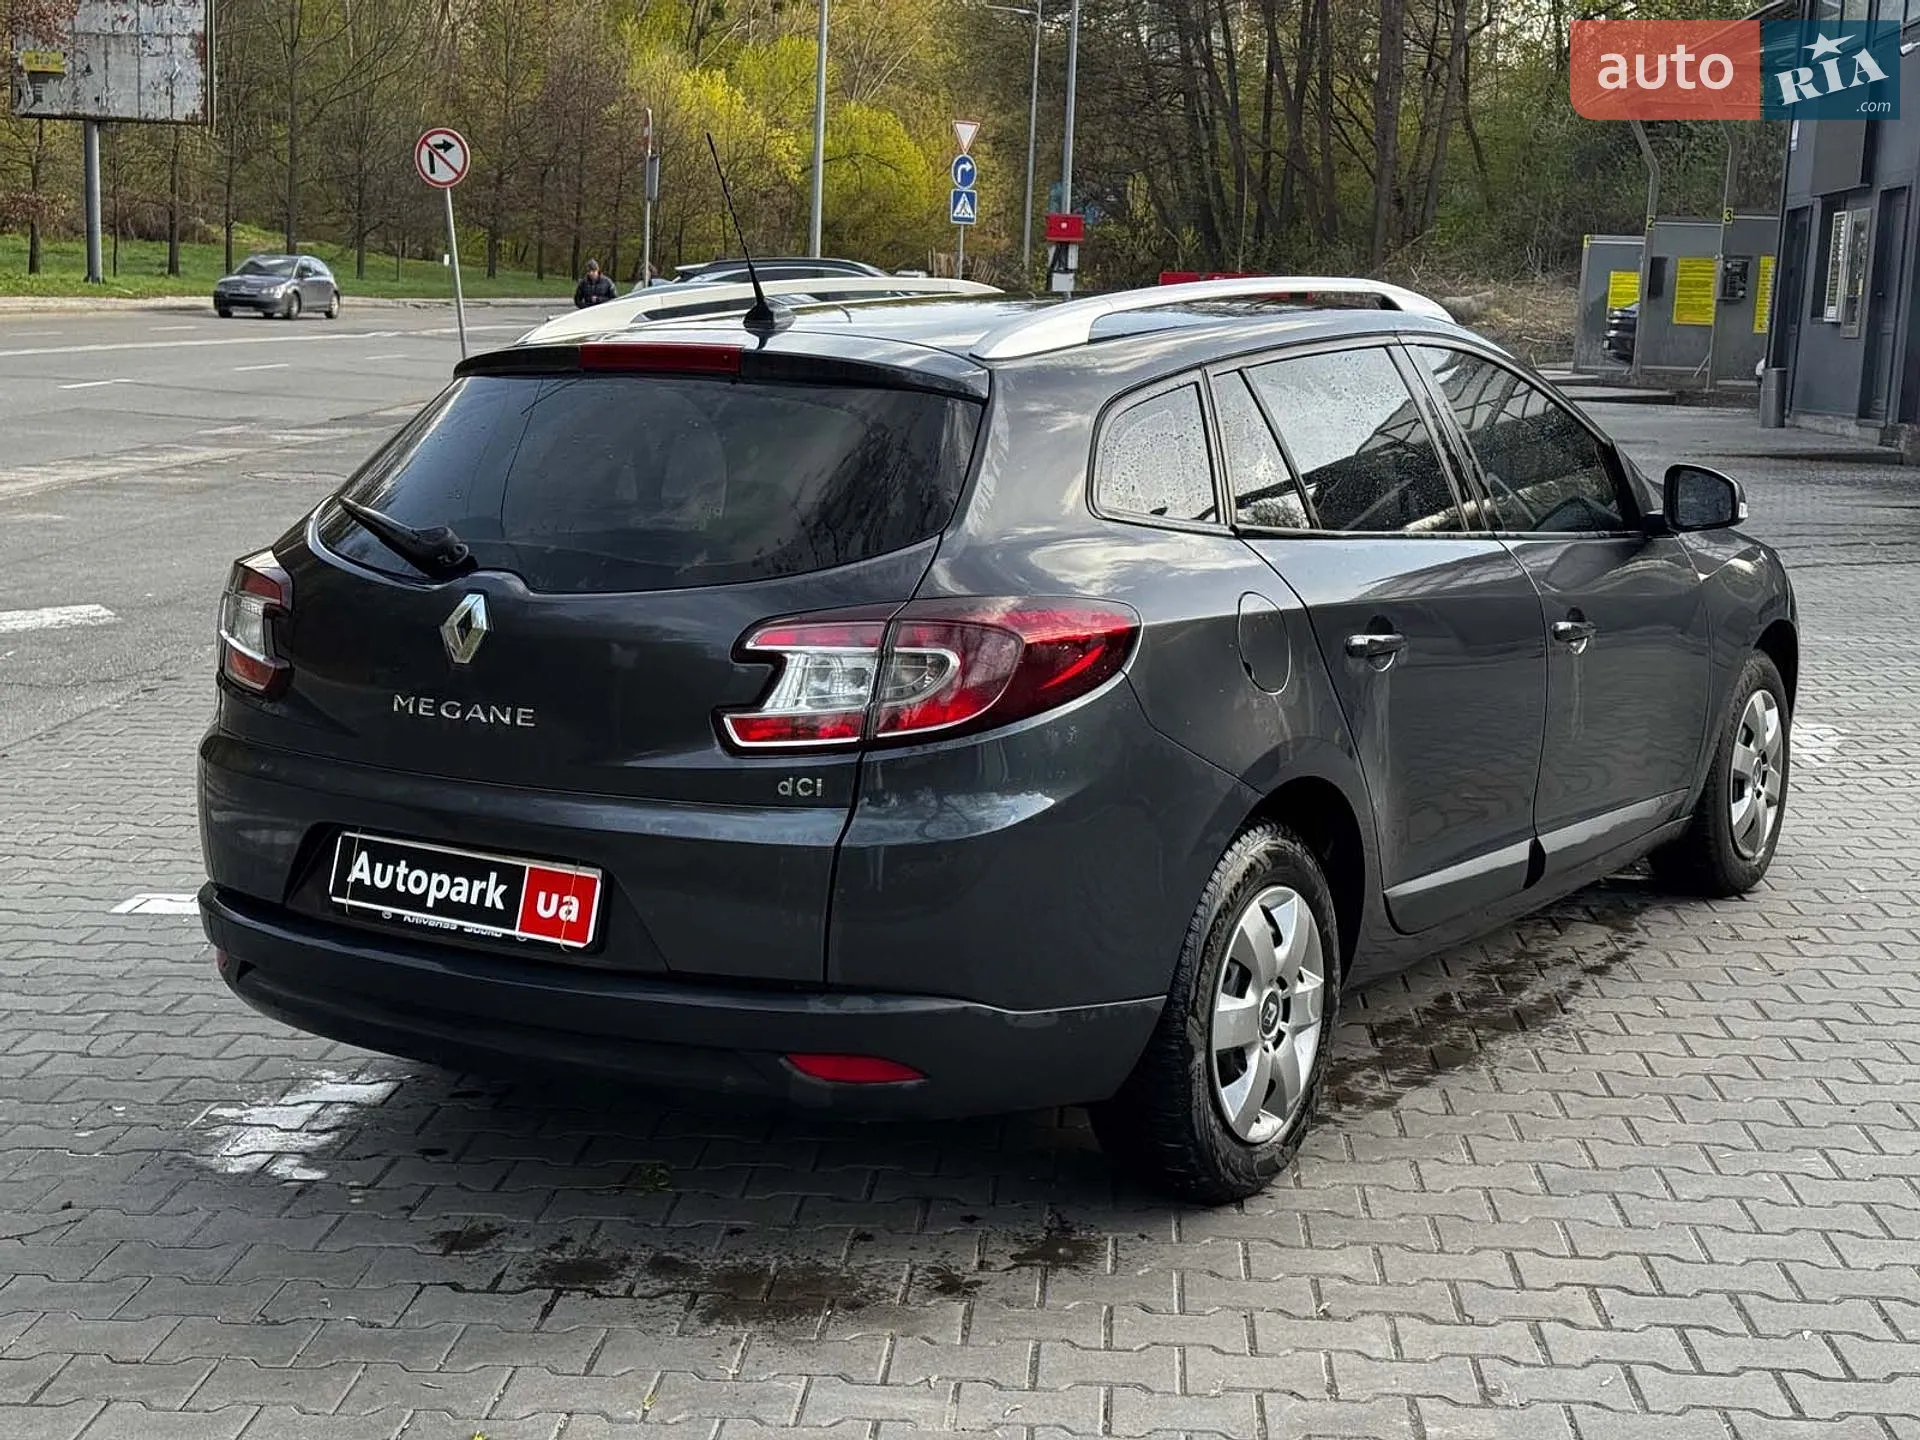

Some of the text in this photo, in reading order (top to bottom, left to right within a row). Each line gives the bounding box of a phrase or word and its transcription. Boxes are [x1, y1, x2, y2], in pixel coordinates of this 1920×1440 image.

[393, 694, 536, 727] MEGANE
[777, 777, 823, 797] dCi
[347, 850, 580, 923] Autopark ua
